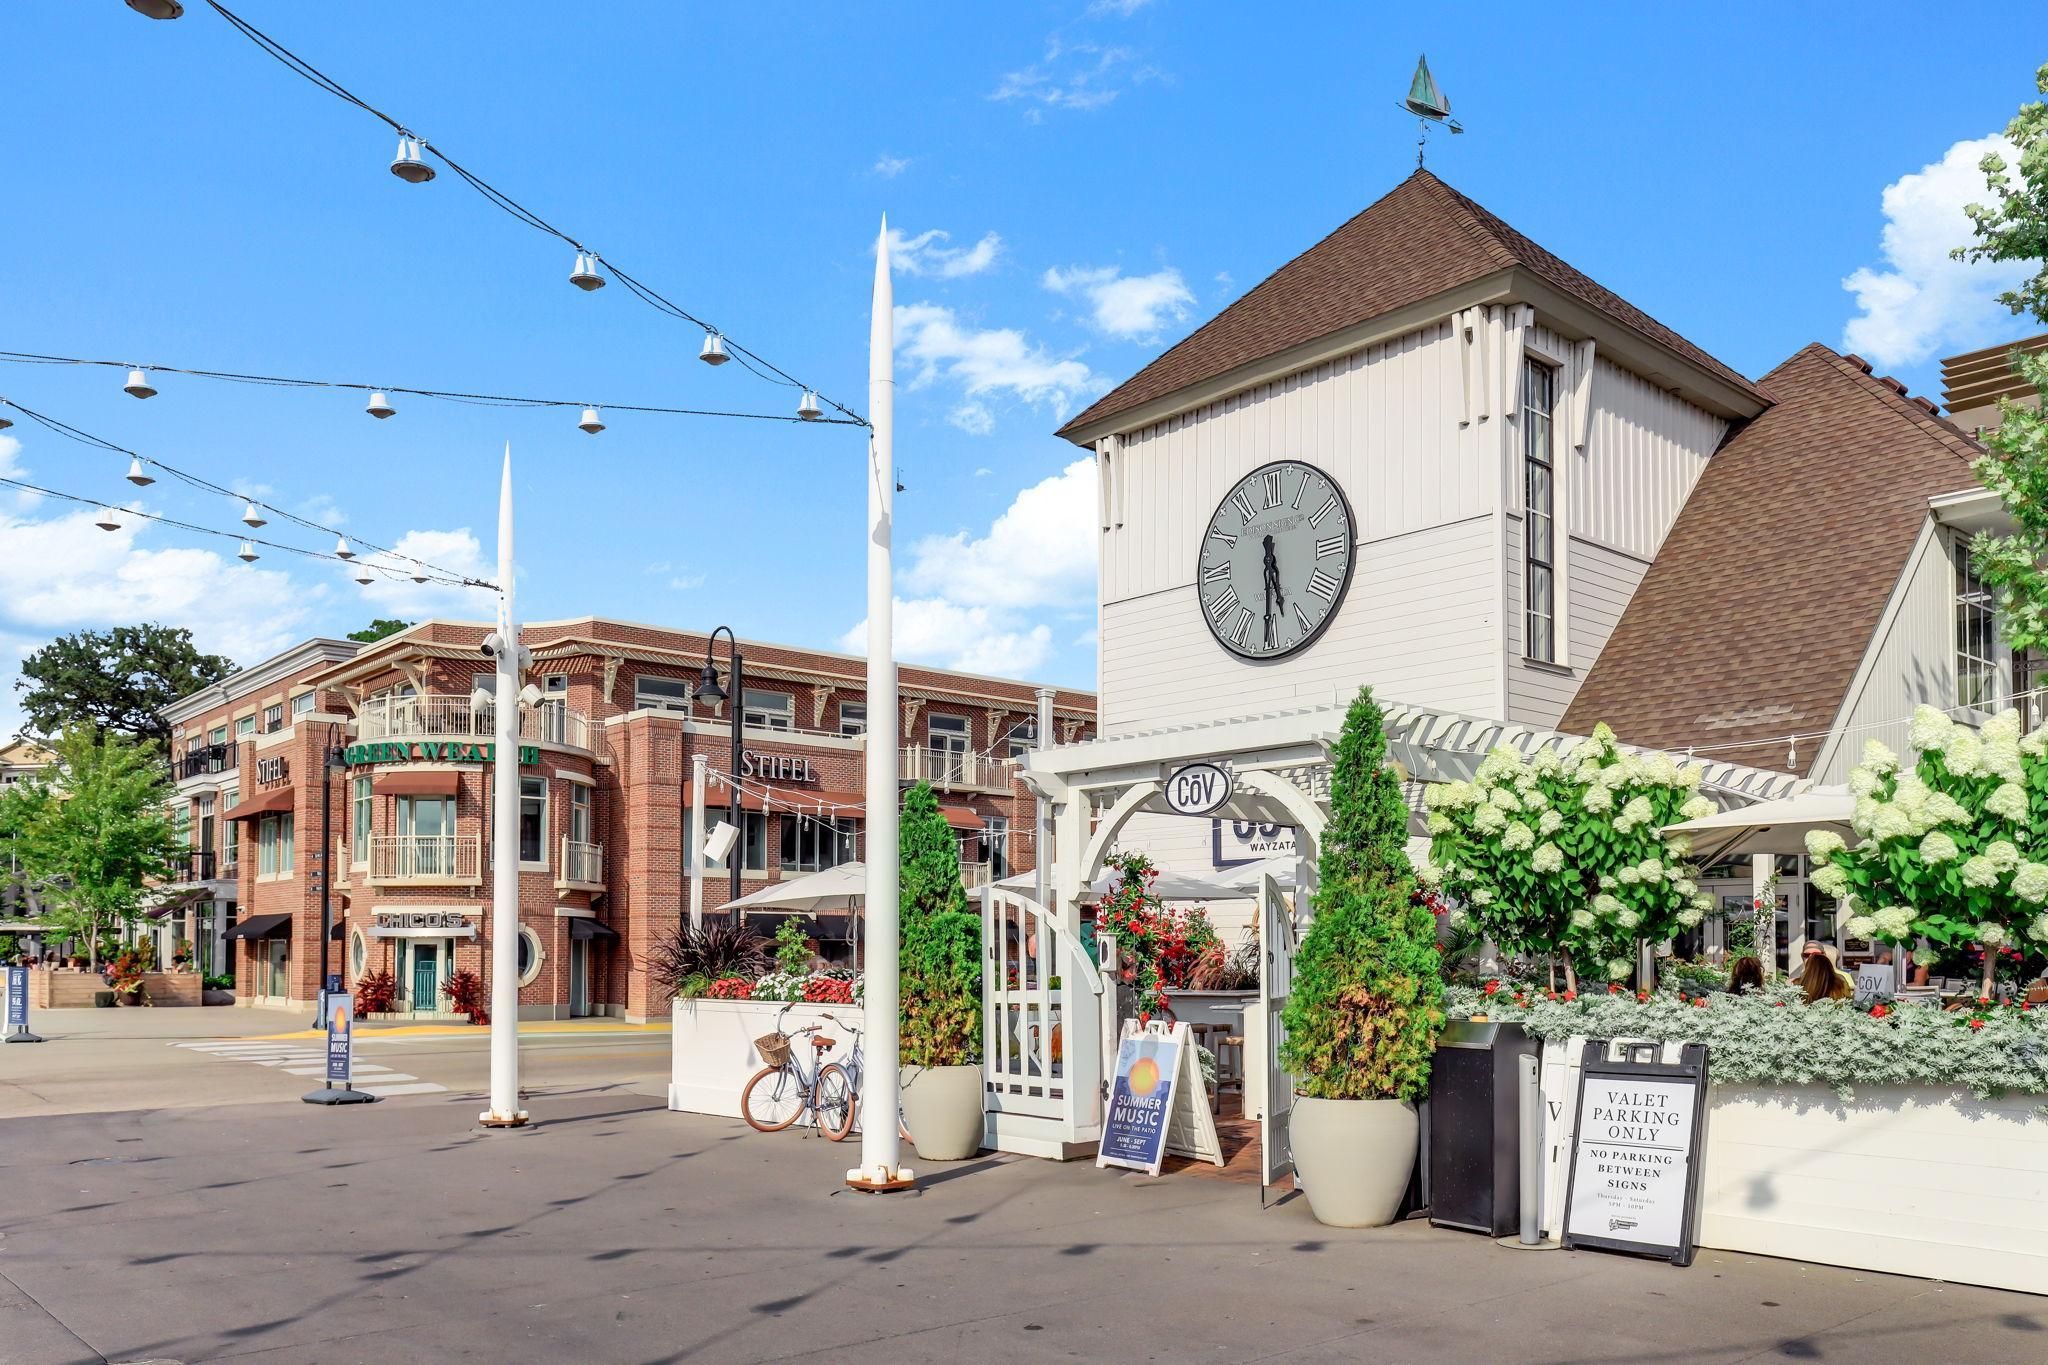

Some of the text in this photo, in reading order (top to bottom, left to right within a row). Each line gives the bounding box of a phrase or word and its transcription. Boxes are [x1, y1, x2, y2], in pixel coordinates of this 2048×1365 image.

[256, 756, 283, 785] STIFEL
[741, 749, 816, 783] STIFEL
[1250, 840, 1296, 852] WAYZATA
[1117, 1095, 1161, 1110] SUMMER
[1607, 1091, 1669, 1108] VALET
[1114, 1107, 1159, 1126] MUSIC
[1593, 1107, 1680, 1126] PARKING
[1141, 1126, 1156, 1134] PATIO
[1608, 1125, 1660, 1142] ONLY
[1590, 1149, 1673, 1165] NO PARKING
[1598, 1164, 1661, 1178] BETWEEN
[1607, 1179, 1647, 1191] SIGNS
